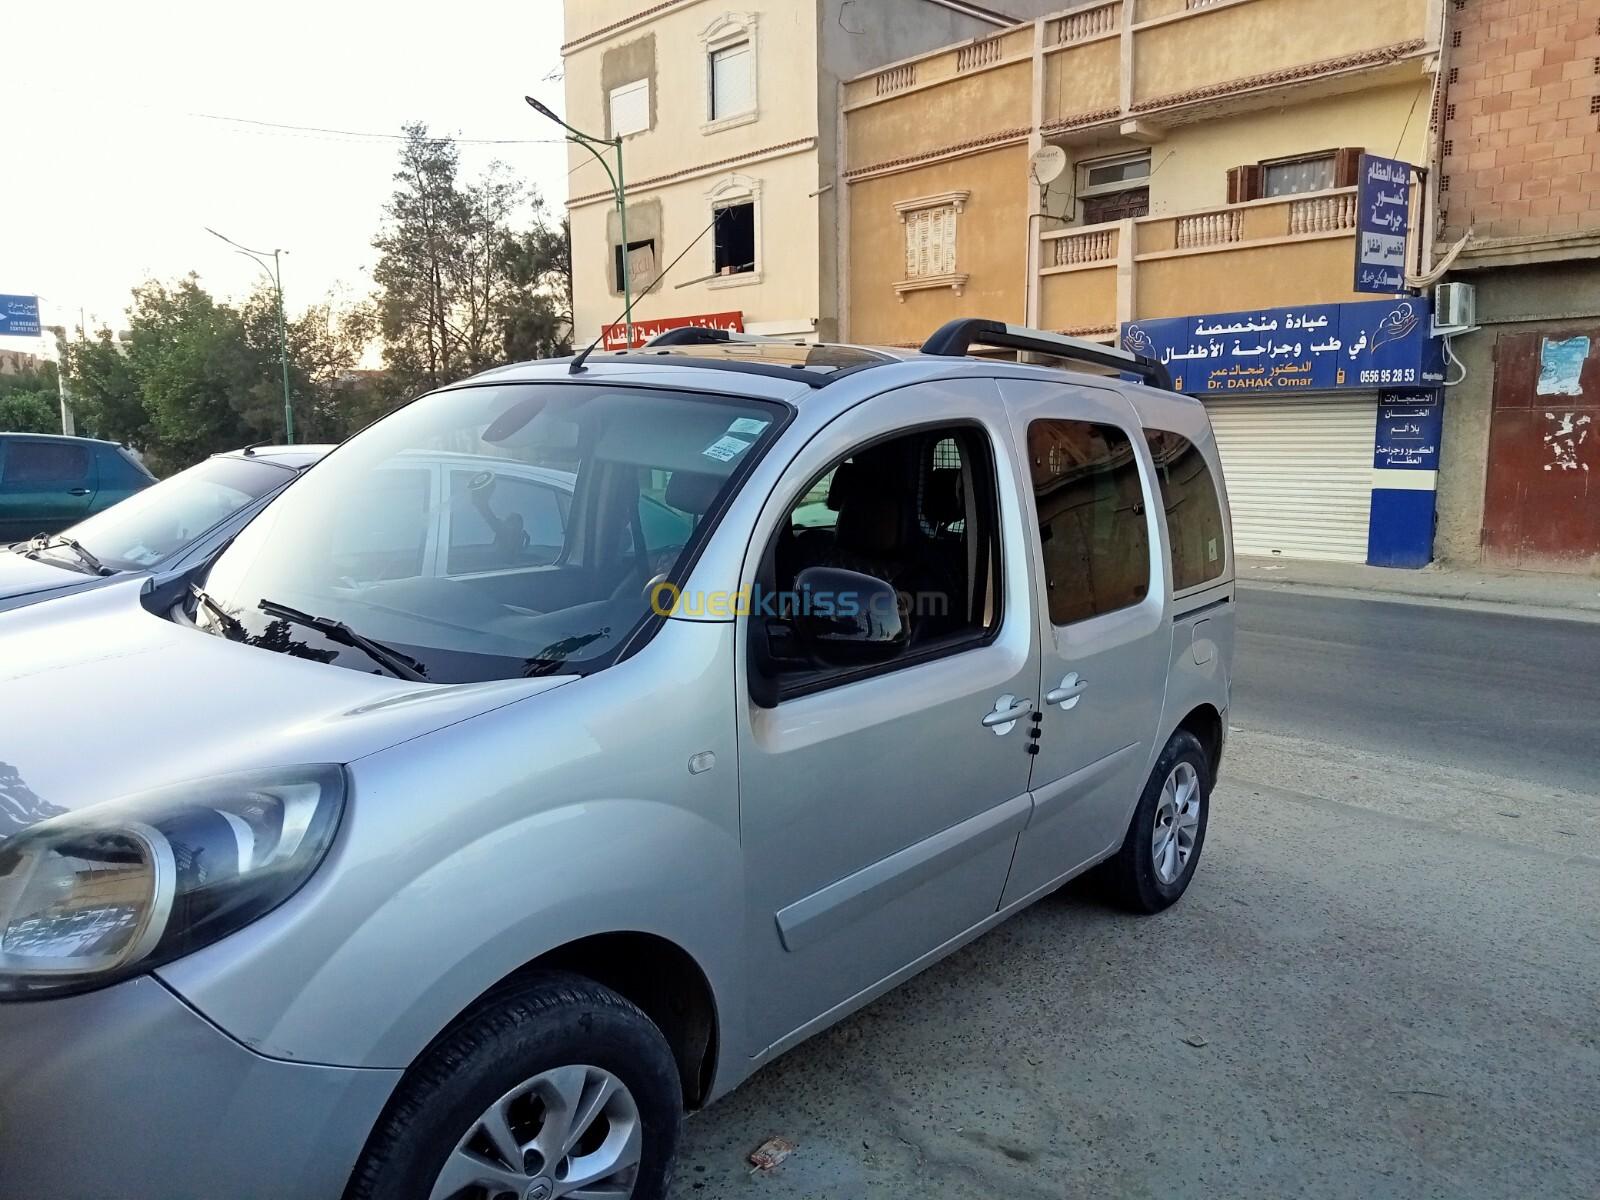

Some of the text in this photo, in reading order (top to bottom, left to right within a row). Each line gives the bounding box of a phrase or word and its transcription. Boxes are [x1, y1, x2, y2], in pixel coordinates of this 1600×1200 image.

[1367, 161, 1405, 188] طب العظام
[1374, 187, 1405, 207] كسور
[1371, 205, 1403, 232] جراحة
[1195, 313, 1328, 335] عيادة متخصصة
[606, 326, 637, 351] الظام
[1160, 330, 1367, 365] في طب وجراحة الأطفال
[1208, 368, 1228, 379] عمر
[1269, 361, 1312, 377] الدكتور
[1360, 371, 1379, 383] 0556
[1380, 370, 1391, 382] 95
[1392, 370, 1402, 382] 28
[1404, 368, 1415, 382] 53
[1207, 377, 1313, 389] Dr. DAHAK Omar
[1385, 409, 1430, 419] الختان
[1376, 445, 1404, 455] وجراحة
[1386, 456, 1422, 465] العظام
